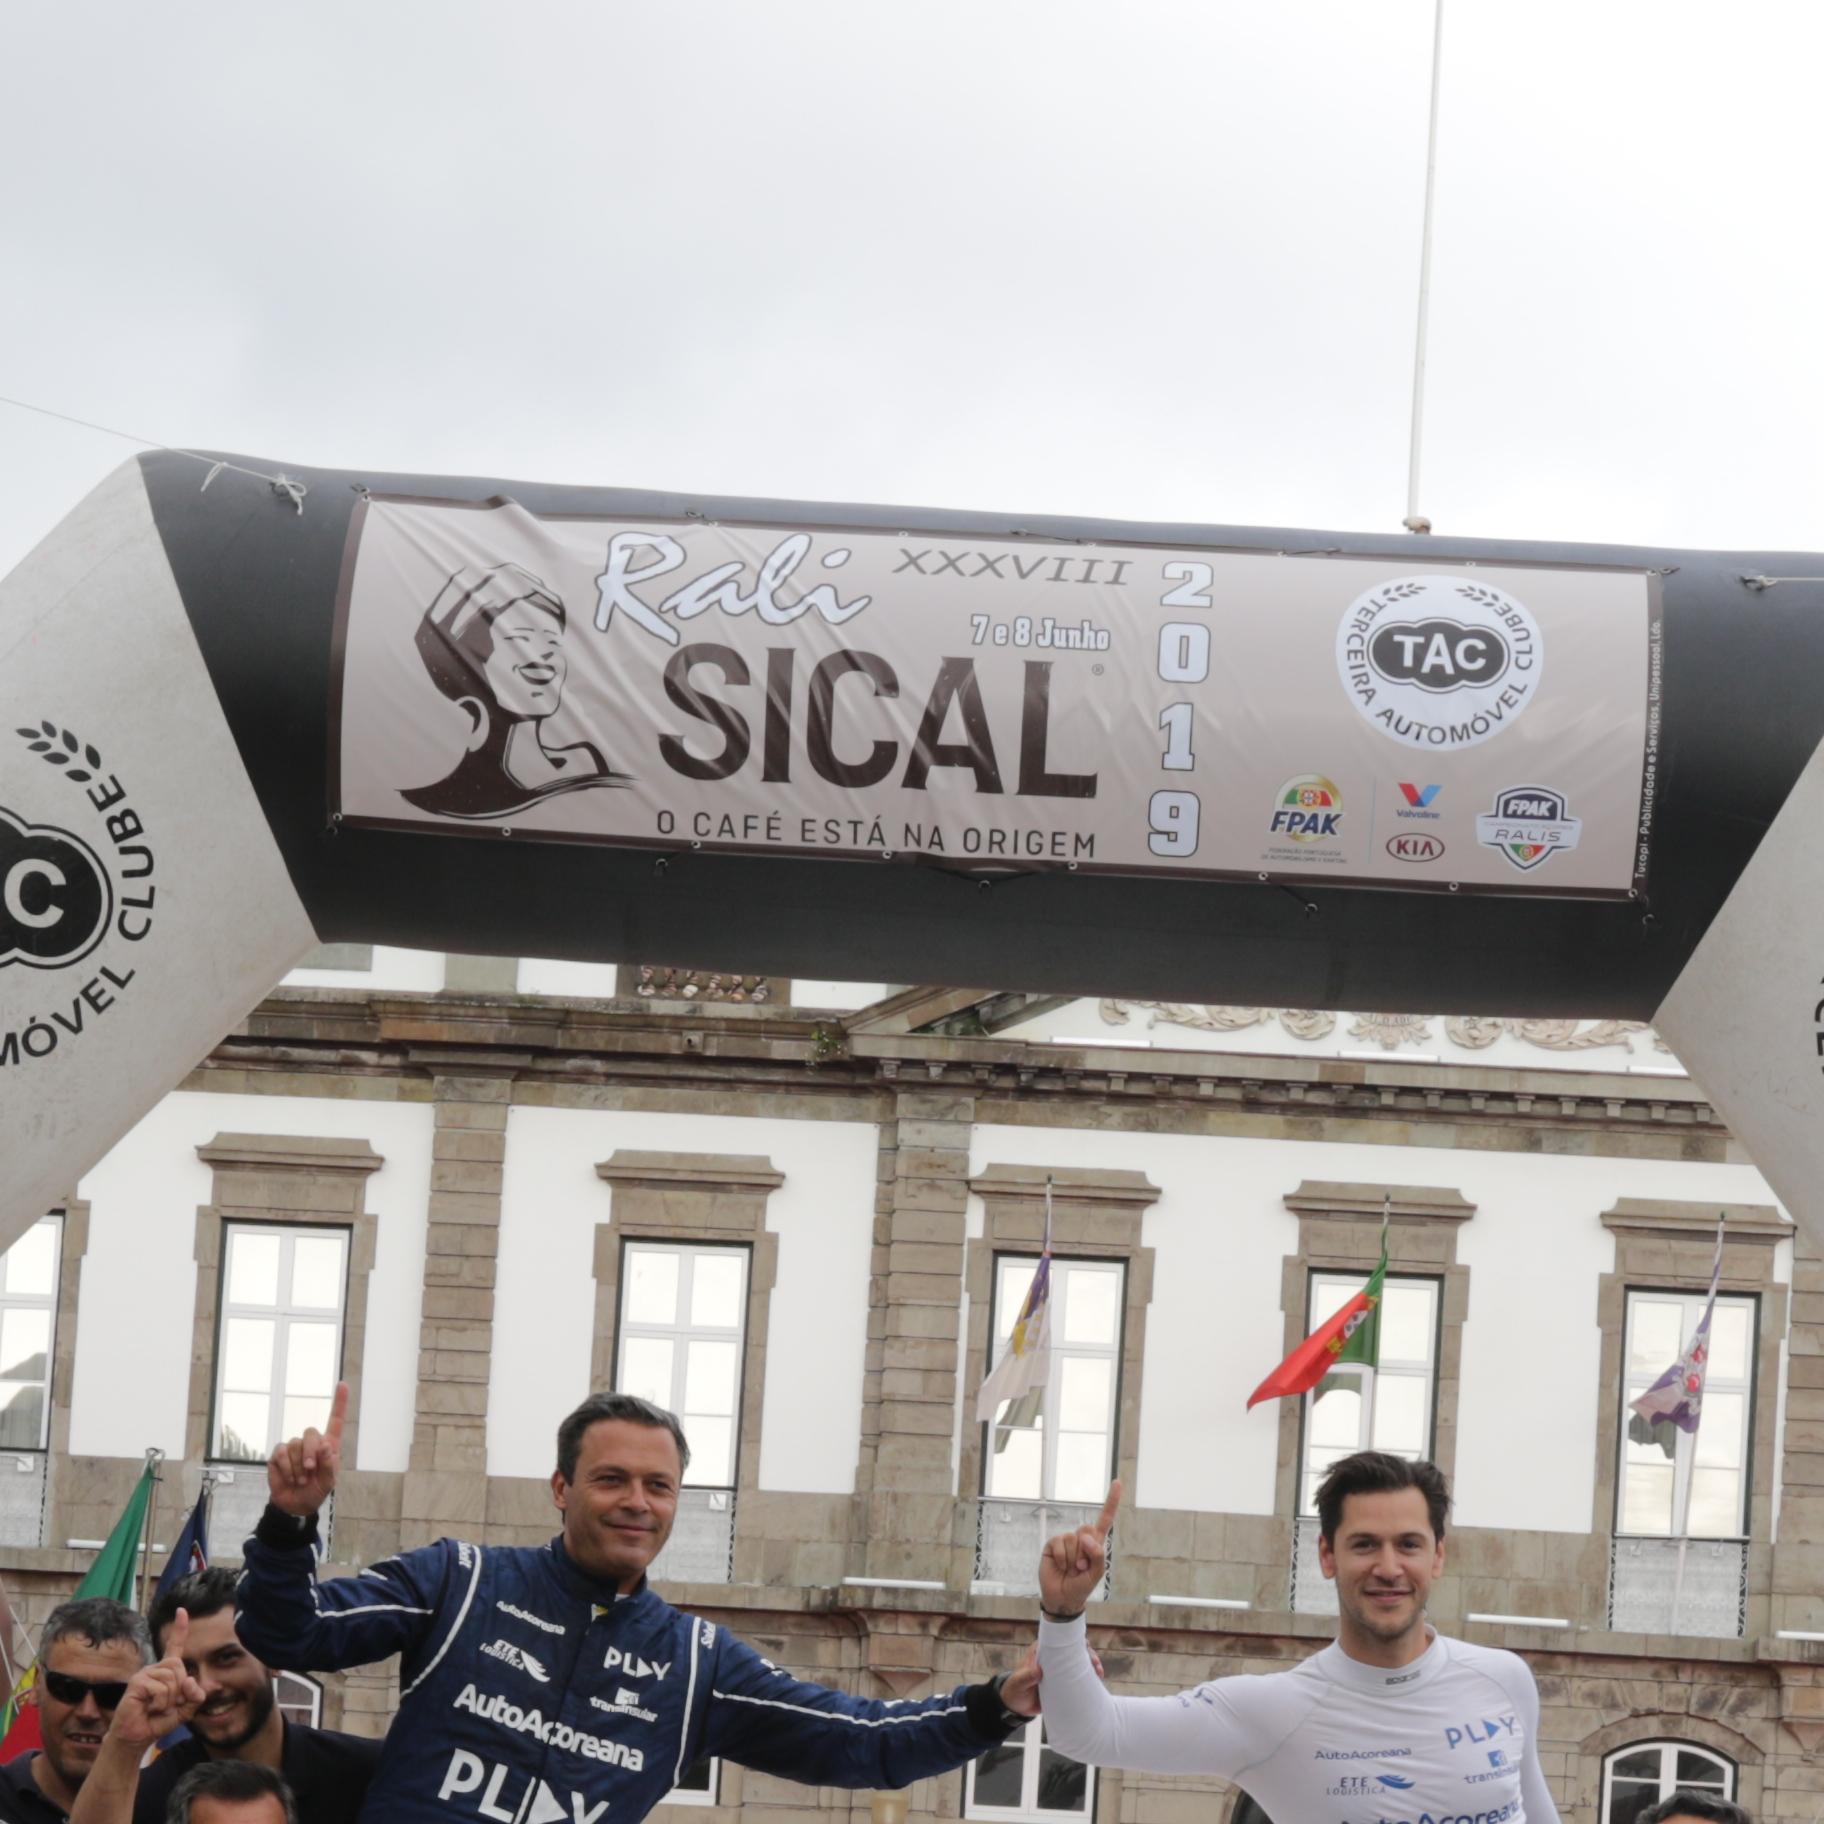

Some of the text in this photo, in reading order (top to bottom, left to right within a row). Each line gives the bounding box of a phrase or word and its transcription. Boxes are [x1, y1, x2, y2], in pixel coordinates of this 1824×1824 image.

[594, 531, 1133, 646] Rali XXXVIII
[971, 613, 1111, 651] 7 e 8 Junho
[1346, 598, 1534, 746] TERCEIRA AUTOMÓVEL CLUBE
[1393, 633, 1487, 676] TAC
[658, 642, 1098, 799] SICAL
[1396, 808, 1441, 820] Valvoline
[1506, 799, 1554, 817] FPAK
[1639, 764, 1657, 835] Publicidade
[656, 810, 1097, 859] O CAFÉ ESTÁ NA ORIGEM
[1269, 809, 1343, 836] FPAK
[1494, 828, 1562, 843] RALIS
[86, 774, 156, 943] CLUBE
[1396, 839, 1435, 856] KIA
[1634, 842, 1650, 879] Tucopi
[493, 1638, 521, 1657] ETE
[1339, 1776, 1370, 1789] ETE
